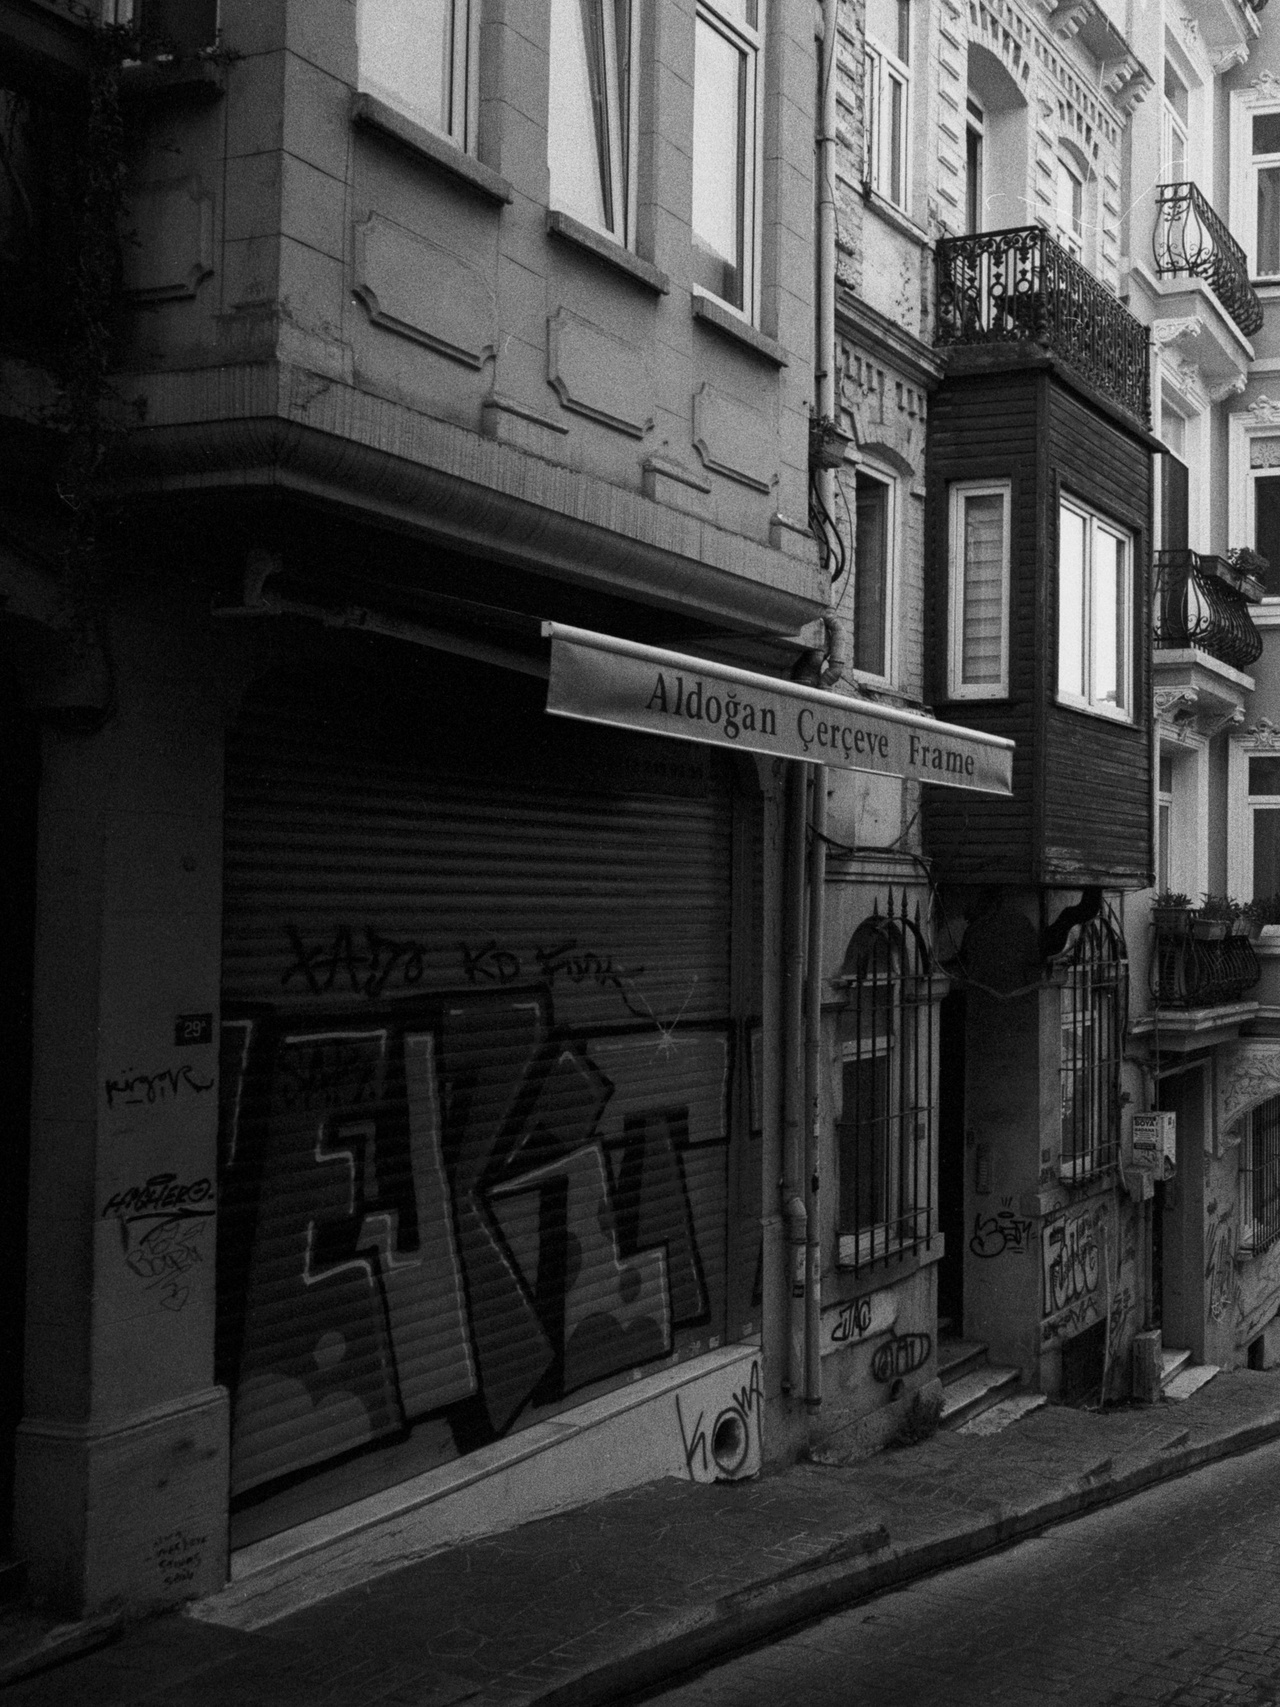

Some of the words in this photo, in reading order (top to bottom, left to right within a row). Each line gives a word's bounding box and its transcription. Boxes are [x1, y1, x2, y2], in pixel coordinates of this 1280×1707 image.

[645, 671, 778, 739] Aldoğan
[797, 708, 889, 759] Çerçeve
[908, 734, 976, 776] Frame
